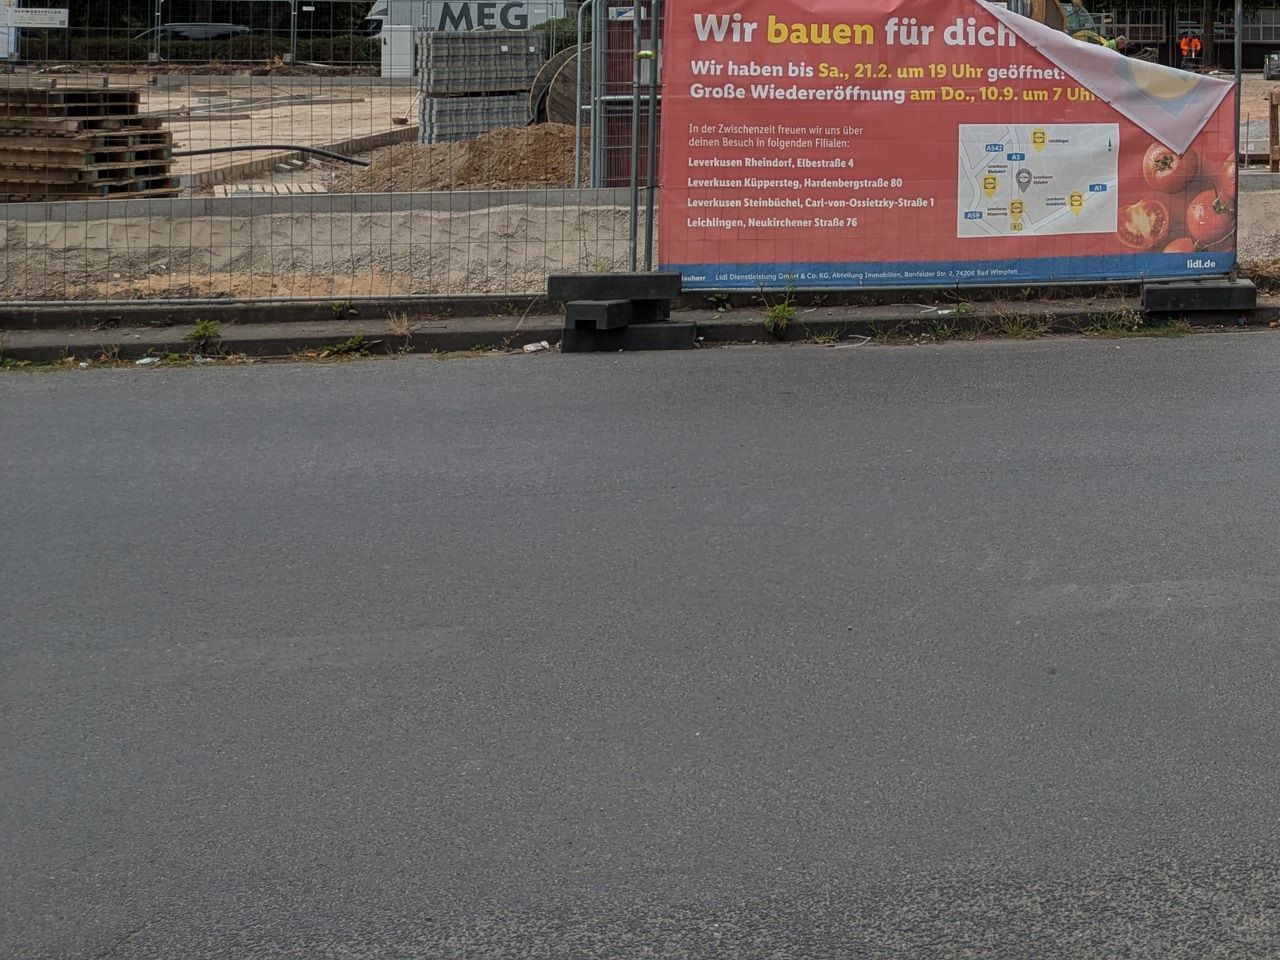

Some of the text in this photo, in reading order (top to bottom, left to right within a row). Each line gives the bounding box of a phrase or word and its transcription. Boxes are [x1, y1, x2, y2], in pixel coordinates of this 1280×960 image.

[438, 0, 529, 32] MEG
[693, 12, 1017, 47] Wir bauen für dich
[690, 59, 724, 76] Wir
[727, 60, 783, 77] haben
[787, 60, 814, 77] bis
[818, 62, 850, 80] Sa.,
[854, 63, 892, 79] 21.2.
[897, 66, 924, 79] um
[928, 63, 947, 79] 19
[952, 63, 984, 79] Uhr
[690, 82, 746, 99] Große
[750, 83, 906, 104] Wiedereröffnung
[910, 89, 937, 101] am
[941, 86, 975, 103] Do.,
[979, 86, 1018, 101] 10.9.
[1022, 89, 1048, 101] um
[1052, 87, 1063, 101] 7
[689, 123, 864, 136] In der Zwischenzeit freuen wir uns über
[688, 136, 850, 150] deinen Besuch in folgenden Filialen:
[986, 144, 1003, 152] A542
[688, 157, 855, 169] Leverkusen Rheindorf, Elbestraße 4
[1011, 153, 1020, 161] A3
[687, 177, 903, 190] Leverkusen Küppersteg, Hardenbergstraße 80
[1094, 184, 1103, 192] A1
[687, 197, 935, 210] Leverkusen Steinbüchel, Carl-von-Ossietzky-Straße 1
[965, 212, 980, 220] A59
[687, 217, 858, 229] Leichlingen, Neukirchener Straße 76
[1187, 259, 1216, 269] lidl.de
[715, 273, 728, 281] Lidl
[729, 272, 777, 282] Dienstleistung
[800, 272, 806, 280] &
[831, 271, 864, 280] Abteilung
[955, 269, 976, 277] 74206
[989, 268, 1018, 277] Wimpfen
